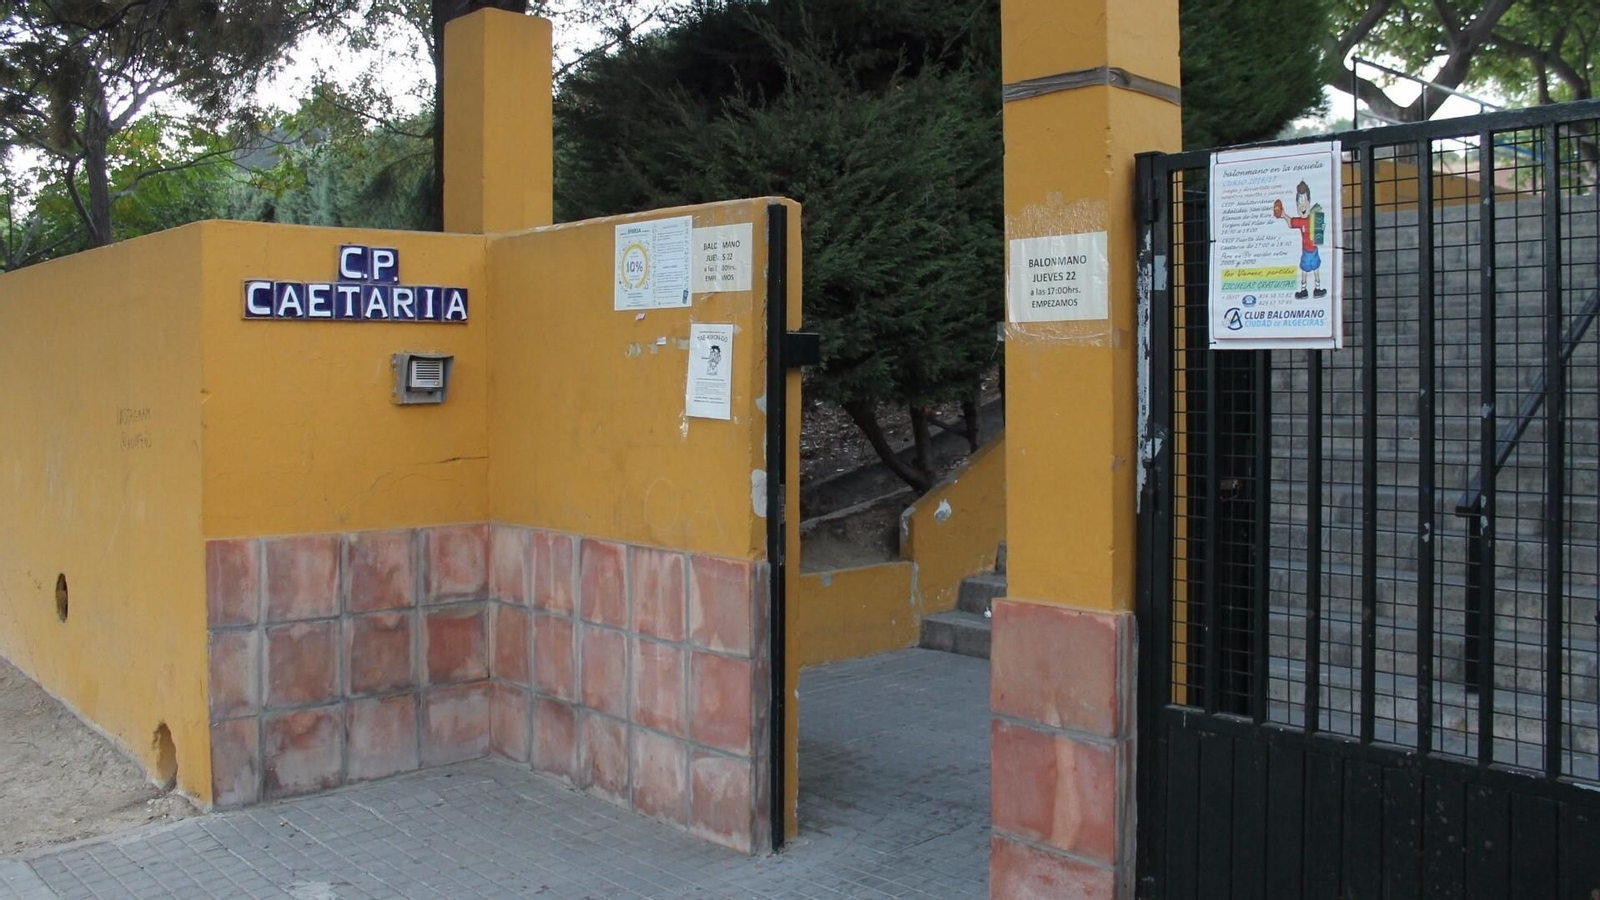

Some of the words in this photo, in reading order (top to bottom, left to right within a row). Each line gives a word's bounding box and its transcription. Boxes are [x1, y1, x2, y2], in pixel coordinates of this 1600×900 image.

[1223, 168, 1268, 178] balonmano
[1282, 164, 1291, 172] la
[1293, 161, 1324, 171] escuela
[1222, 179, 1247, 187] CURSO
[340, 247, 398, 281] C.P.
[1028, 255, 1087, 268] BALONMANO
[626, 261, 644, 273] 10%
[1032, 272, 1064, 282] JUEVES
[1066, 271, 1076, 280] 22
[1222, 282, 1256, 290] ESCUELAS
[1258, 280, 1296, 290] GRATUITAS
[1036, 288, 1046, 296] las
[1048, 286, 1081, 295] 17:00hrs.
[247, 282, 468, 320] CAETARIA
[1032, 298, 1078, 308] EMPEZAMOS
[1244, 311, 1266, 320] CLUB
[1267, 310, 1325, 319] BALONMANO
[1244, 320, 1272, 328] CIUDAD
[1282, 318, 1324, 328] ALGECIRAS
